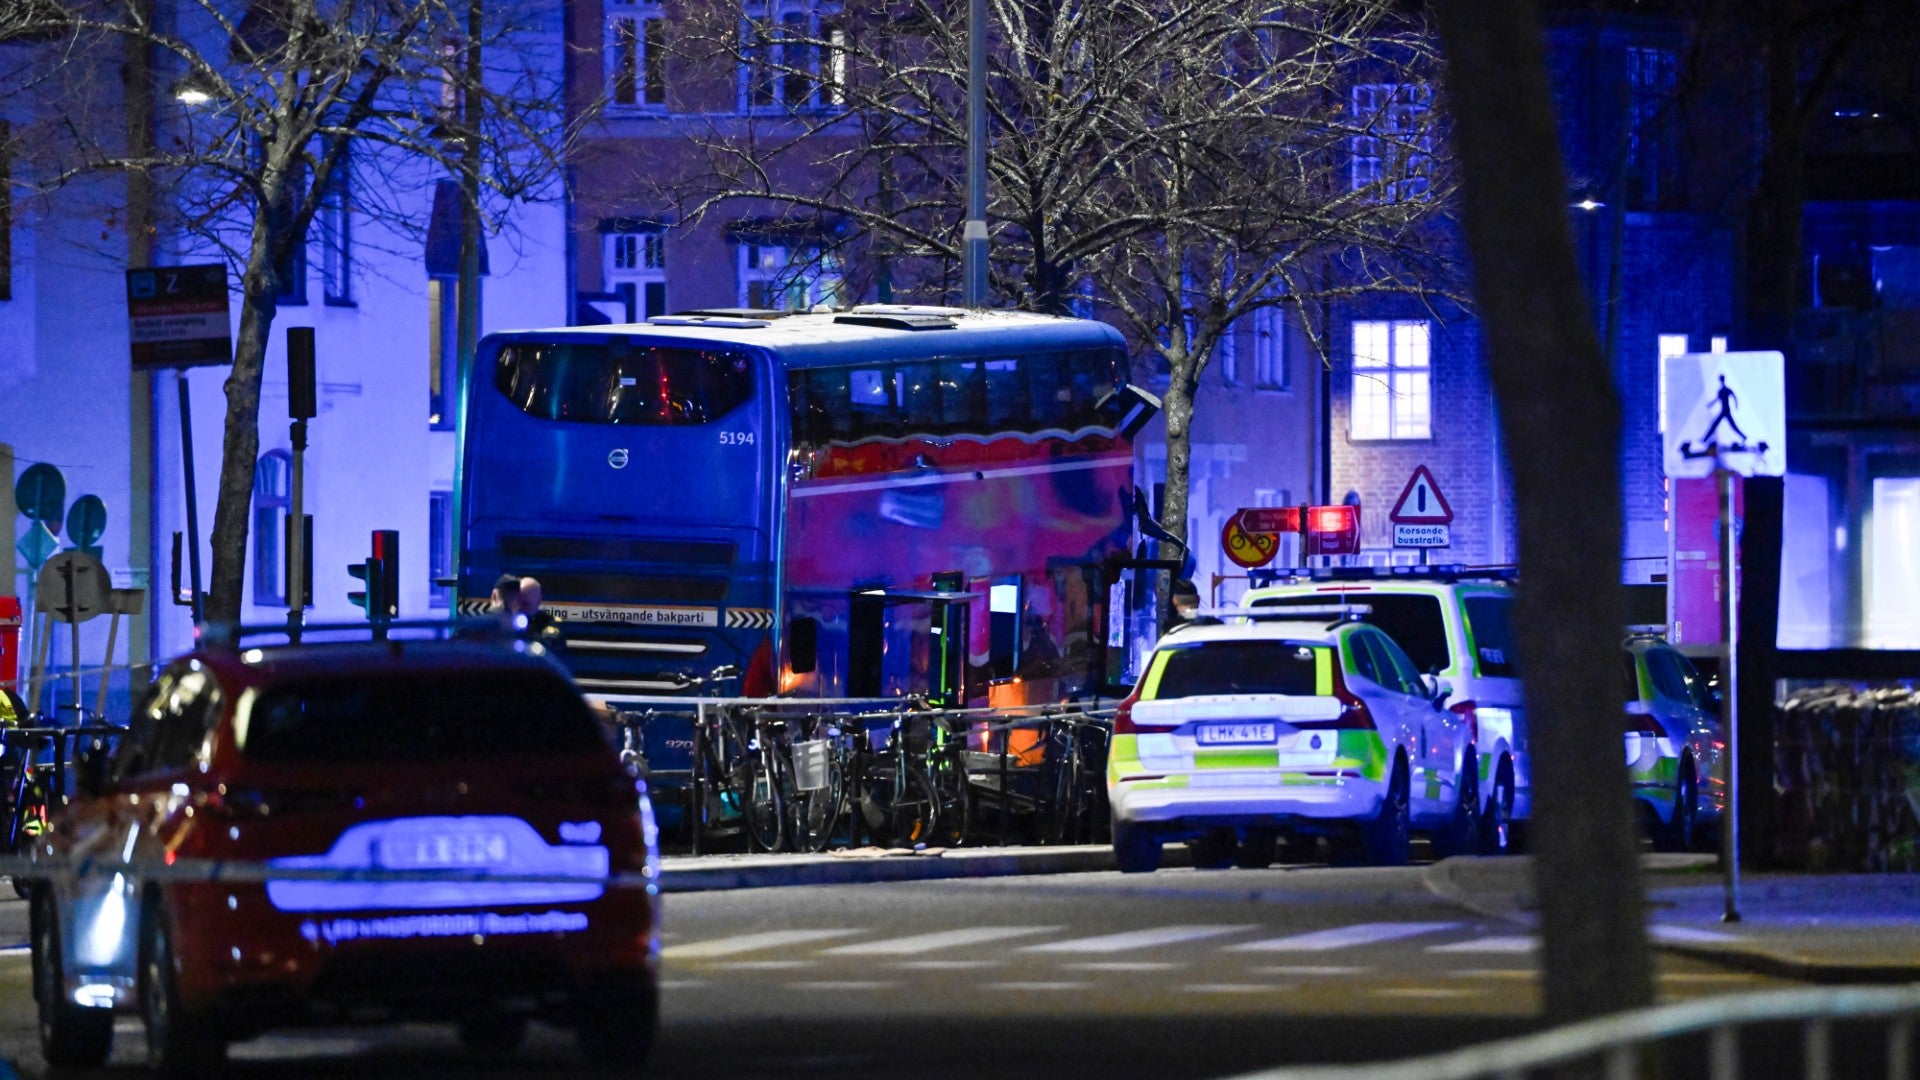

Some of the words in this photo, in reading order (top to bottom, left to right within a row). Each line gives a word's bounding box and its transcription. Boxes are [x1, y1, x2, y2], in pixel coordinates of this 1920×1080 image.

[719, 431, 755, 445] 5194
[1399, 526, 1444, 535] Korsande
[1397, 536, 1445, 544] busstrafik
[581, 608, 653, 623] utsvängande
[657, 611, 704, 624] bakparti
[1209, 726, 1236, 740] LMK
[1241, 725, 1268, 739] 41E
